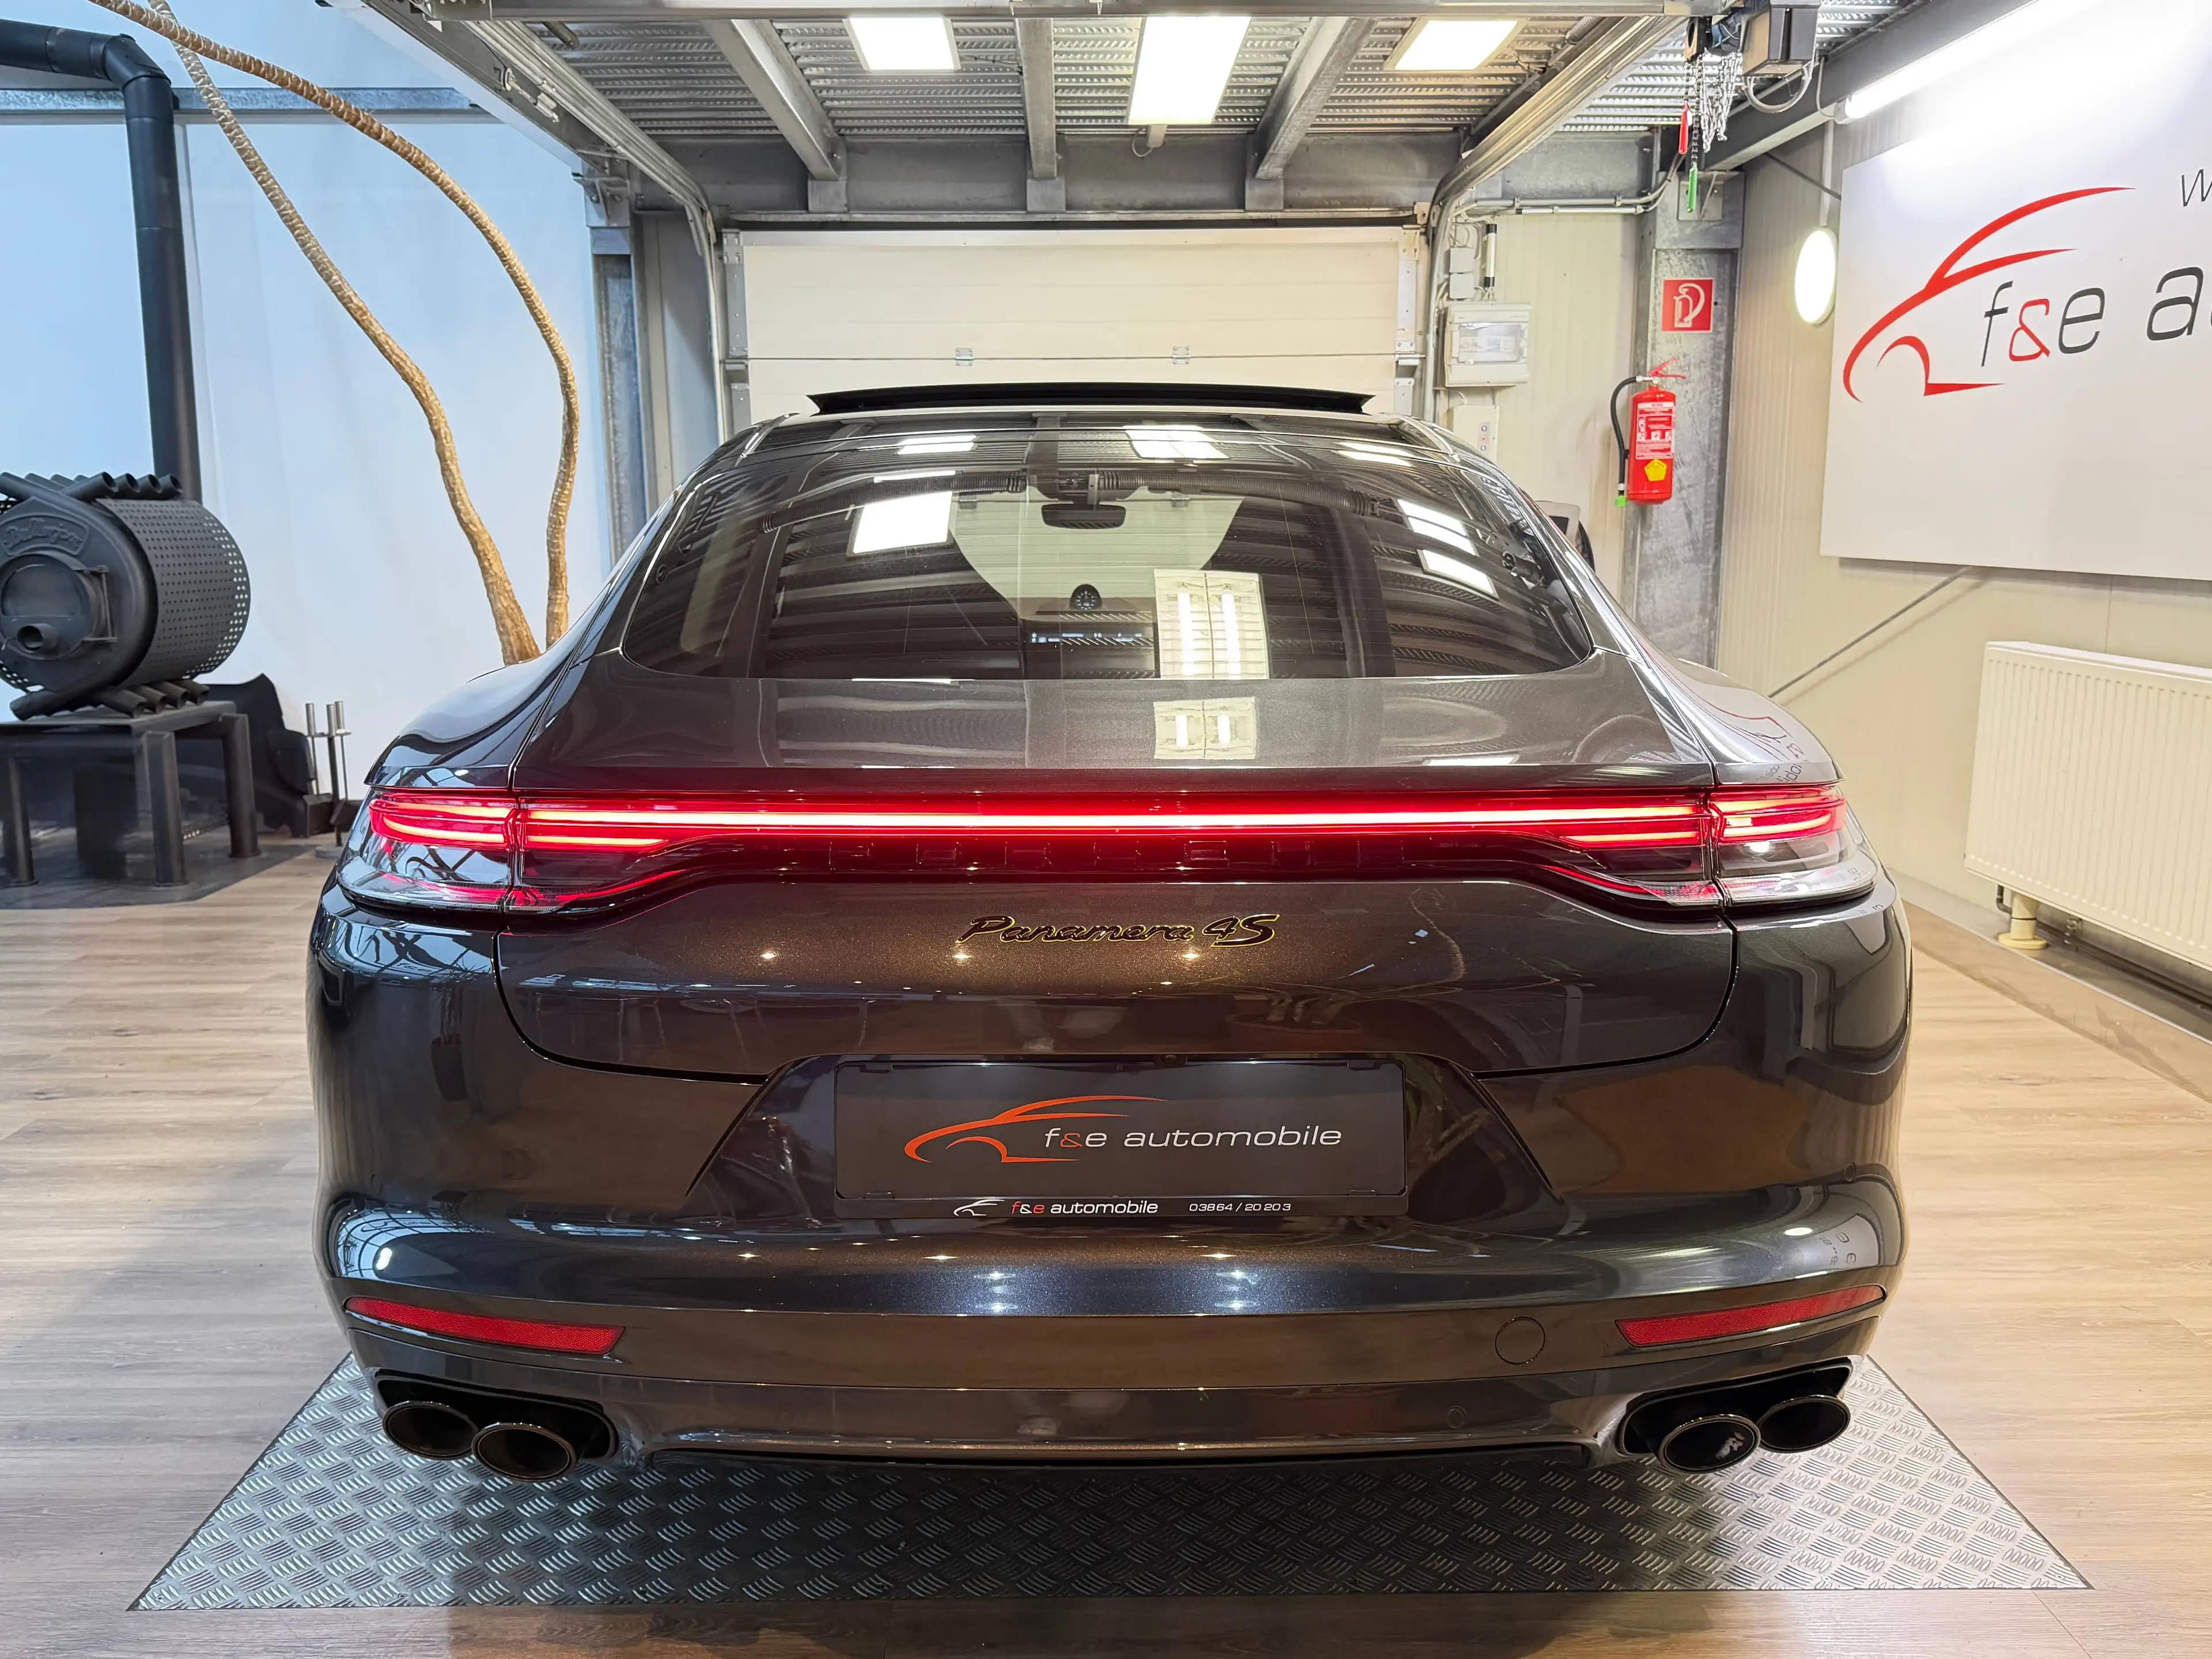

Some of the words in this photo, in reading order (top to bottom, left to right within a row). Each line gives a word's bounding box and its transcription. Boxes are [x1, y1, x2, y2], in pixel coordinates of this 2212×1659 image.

[1980, 280, 2105, 368] f&e
[2146, 266, 2212, 342] a
[954, 914, 1194, 944] Panamera
[1201, 914, 1280, 948] 4S
[1045, 1127, 1107, 1149] f&e
[1124, 1125, 1343, 1147] automobile
[1011, 1200, 1045, 1214] f&e
[1050, 1200, 1159, 1214] automobile
[1189, 1203, 1233, 1212] 03864
